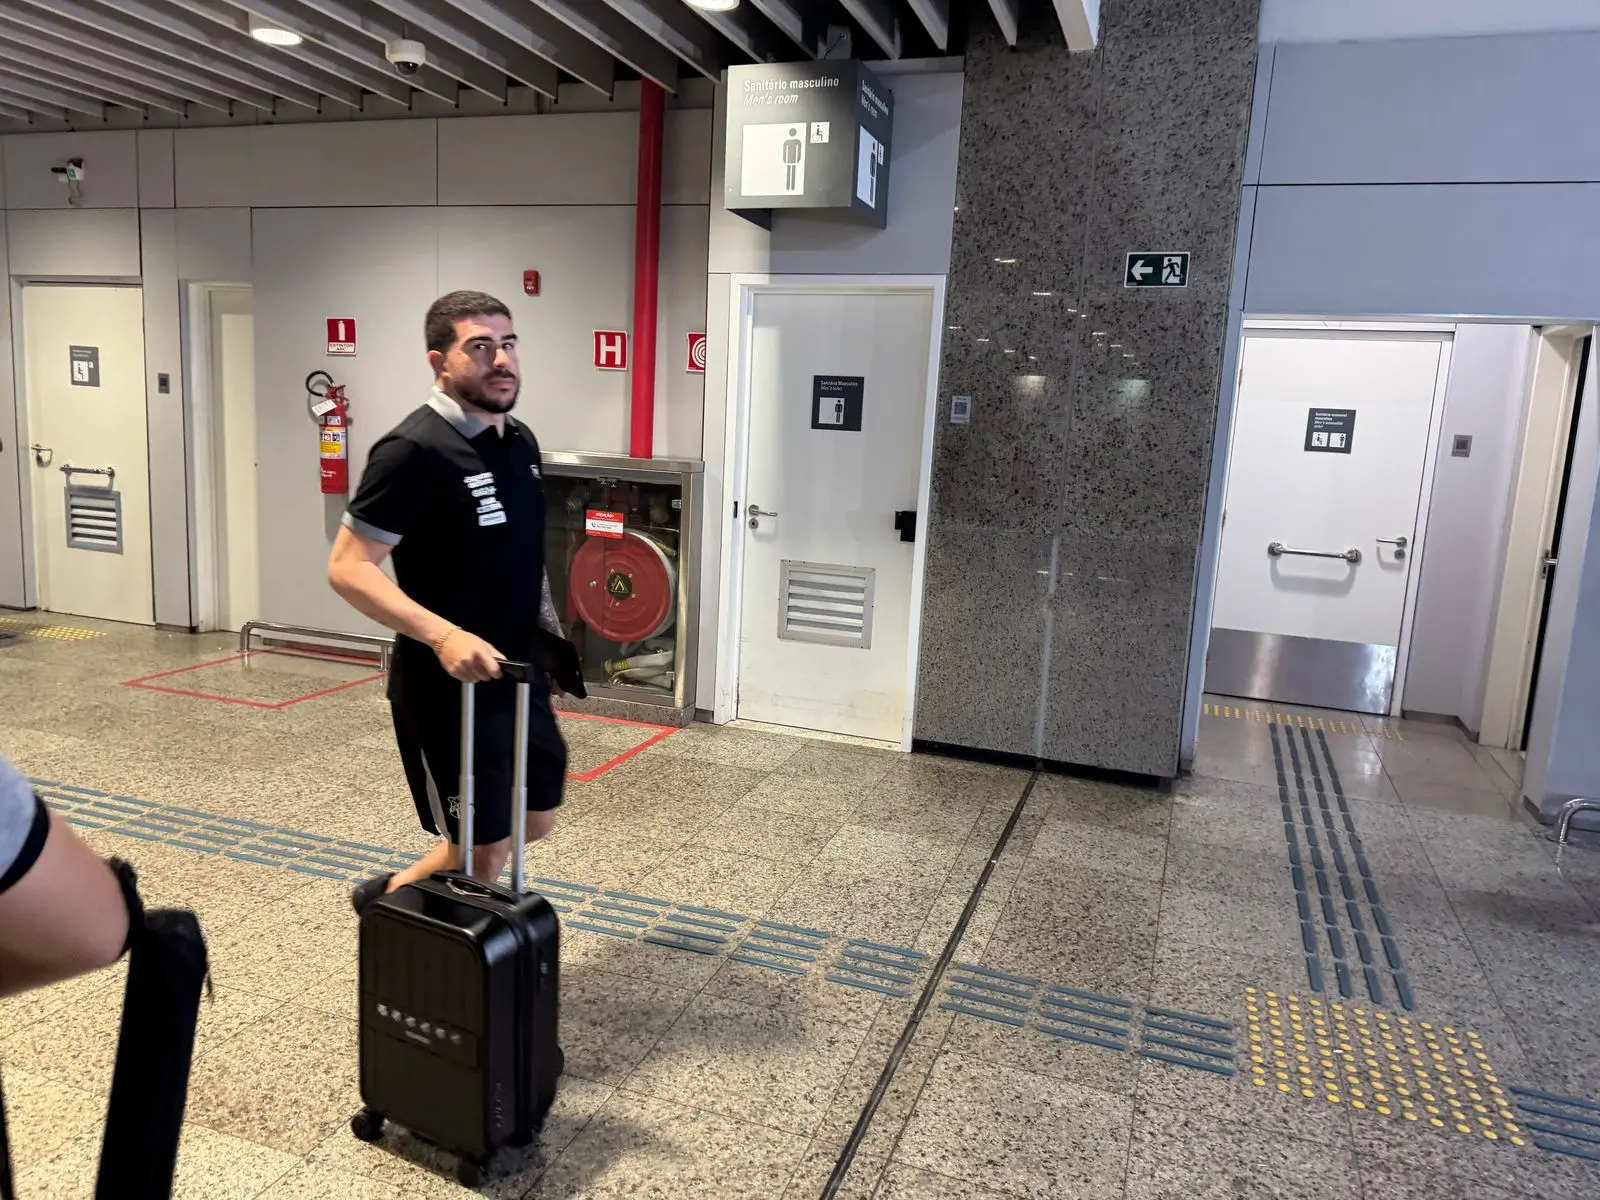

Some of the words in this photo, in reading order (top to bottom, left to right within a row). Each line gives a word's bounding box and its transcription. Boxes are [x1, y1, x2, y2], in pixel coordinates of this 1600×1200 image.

[743, 78, 787, 92] Sanitário
[789, 76, 840, 89] masculino
[743, 93, 773, 106] Men's
[774, 93, 799, 104] room
[599, 334, 622, 366] H
